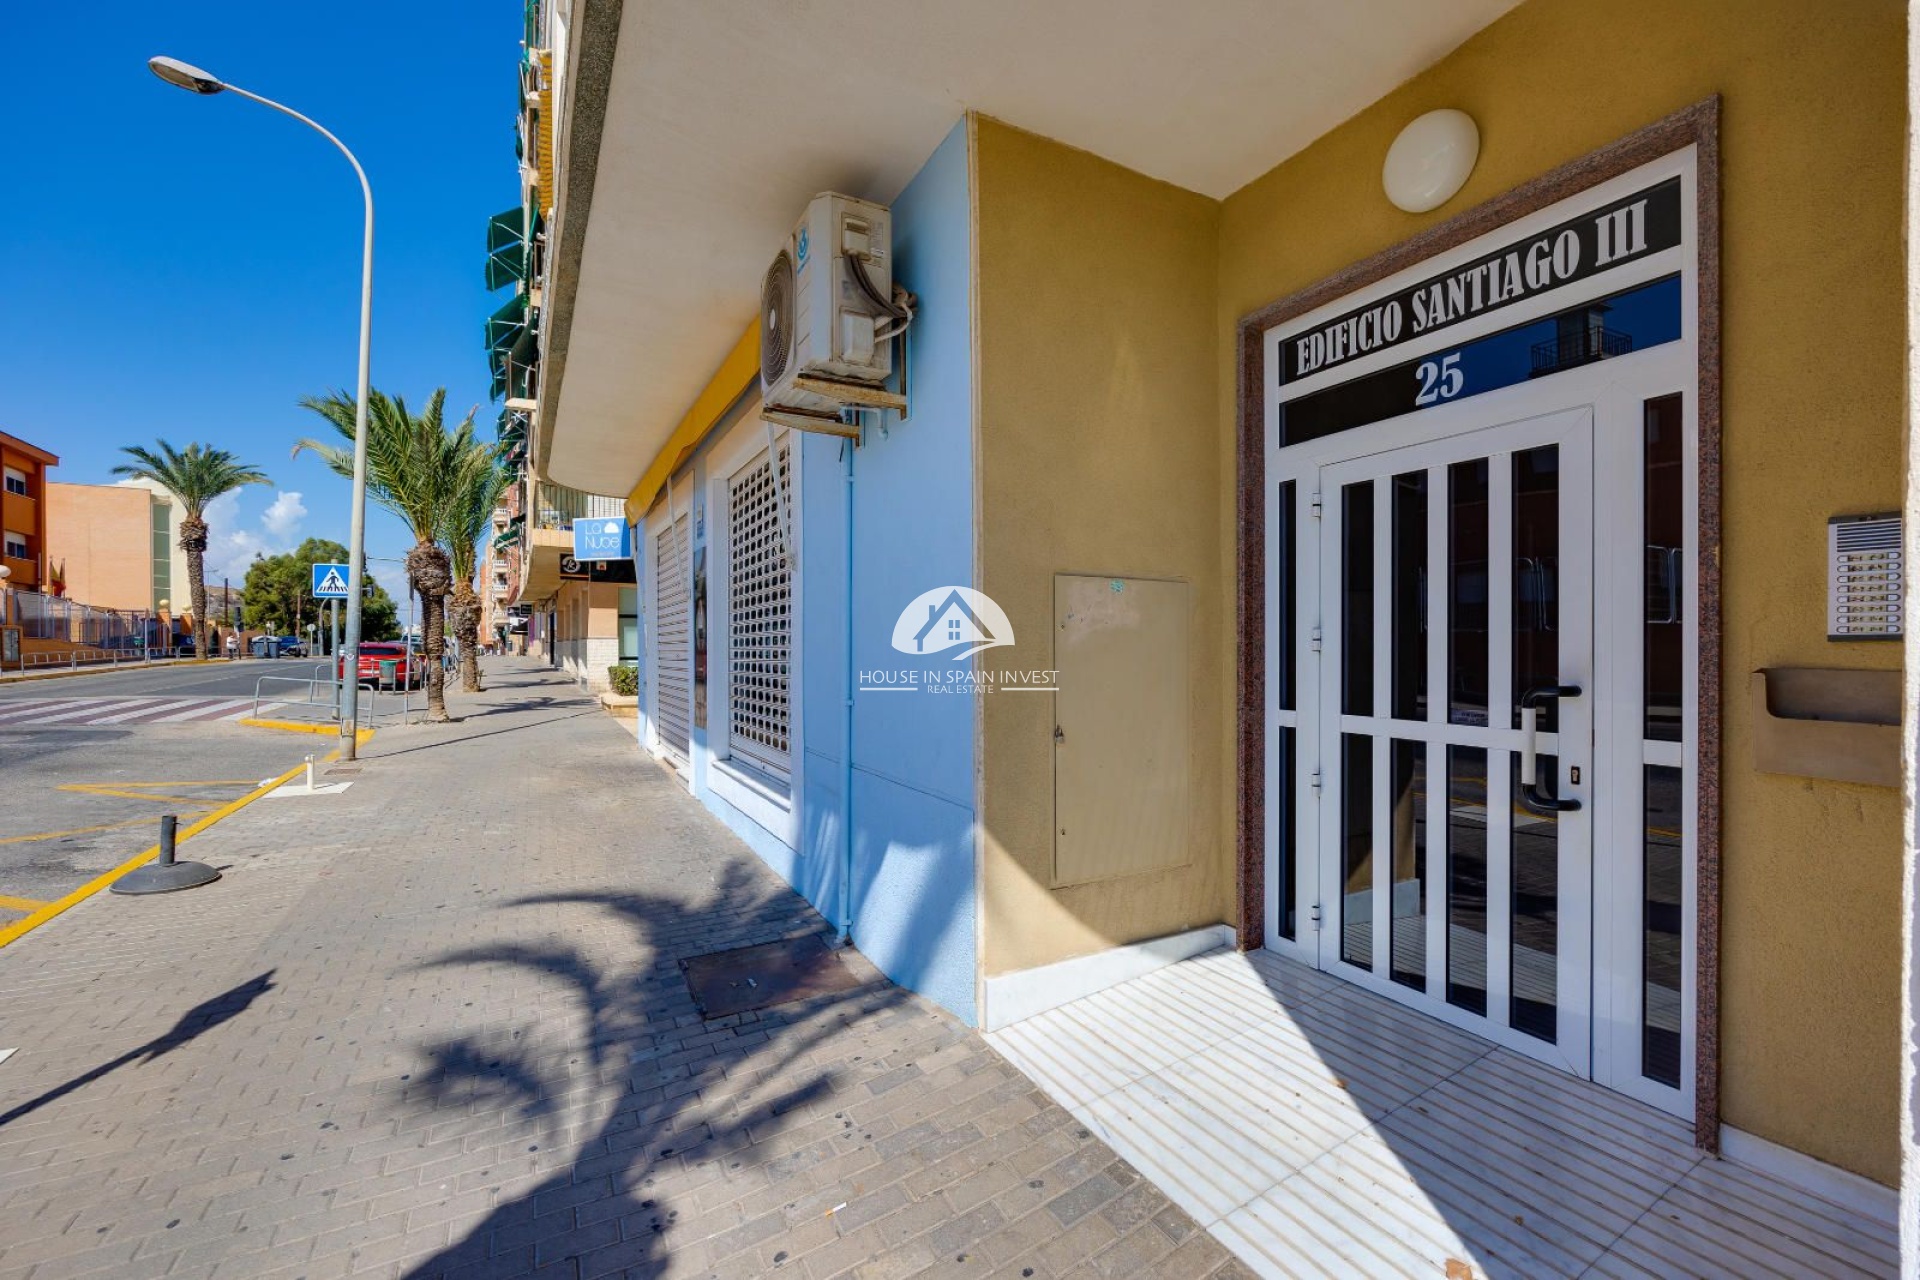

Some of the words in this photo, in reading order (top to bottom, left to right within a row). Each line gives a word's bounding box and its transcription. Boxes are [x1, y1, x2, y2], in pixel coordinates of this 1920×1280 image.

[1296, 300, 1403, 376] EDIFICIO
[1411, 229, 1581, 334] SANTIAGO
[1594, 199, 1649, 268] III
[1415, 352, 1464, 407] 25
[585, 523, 602, 535] La
